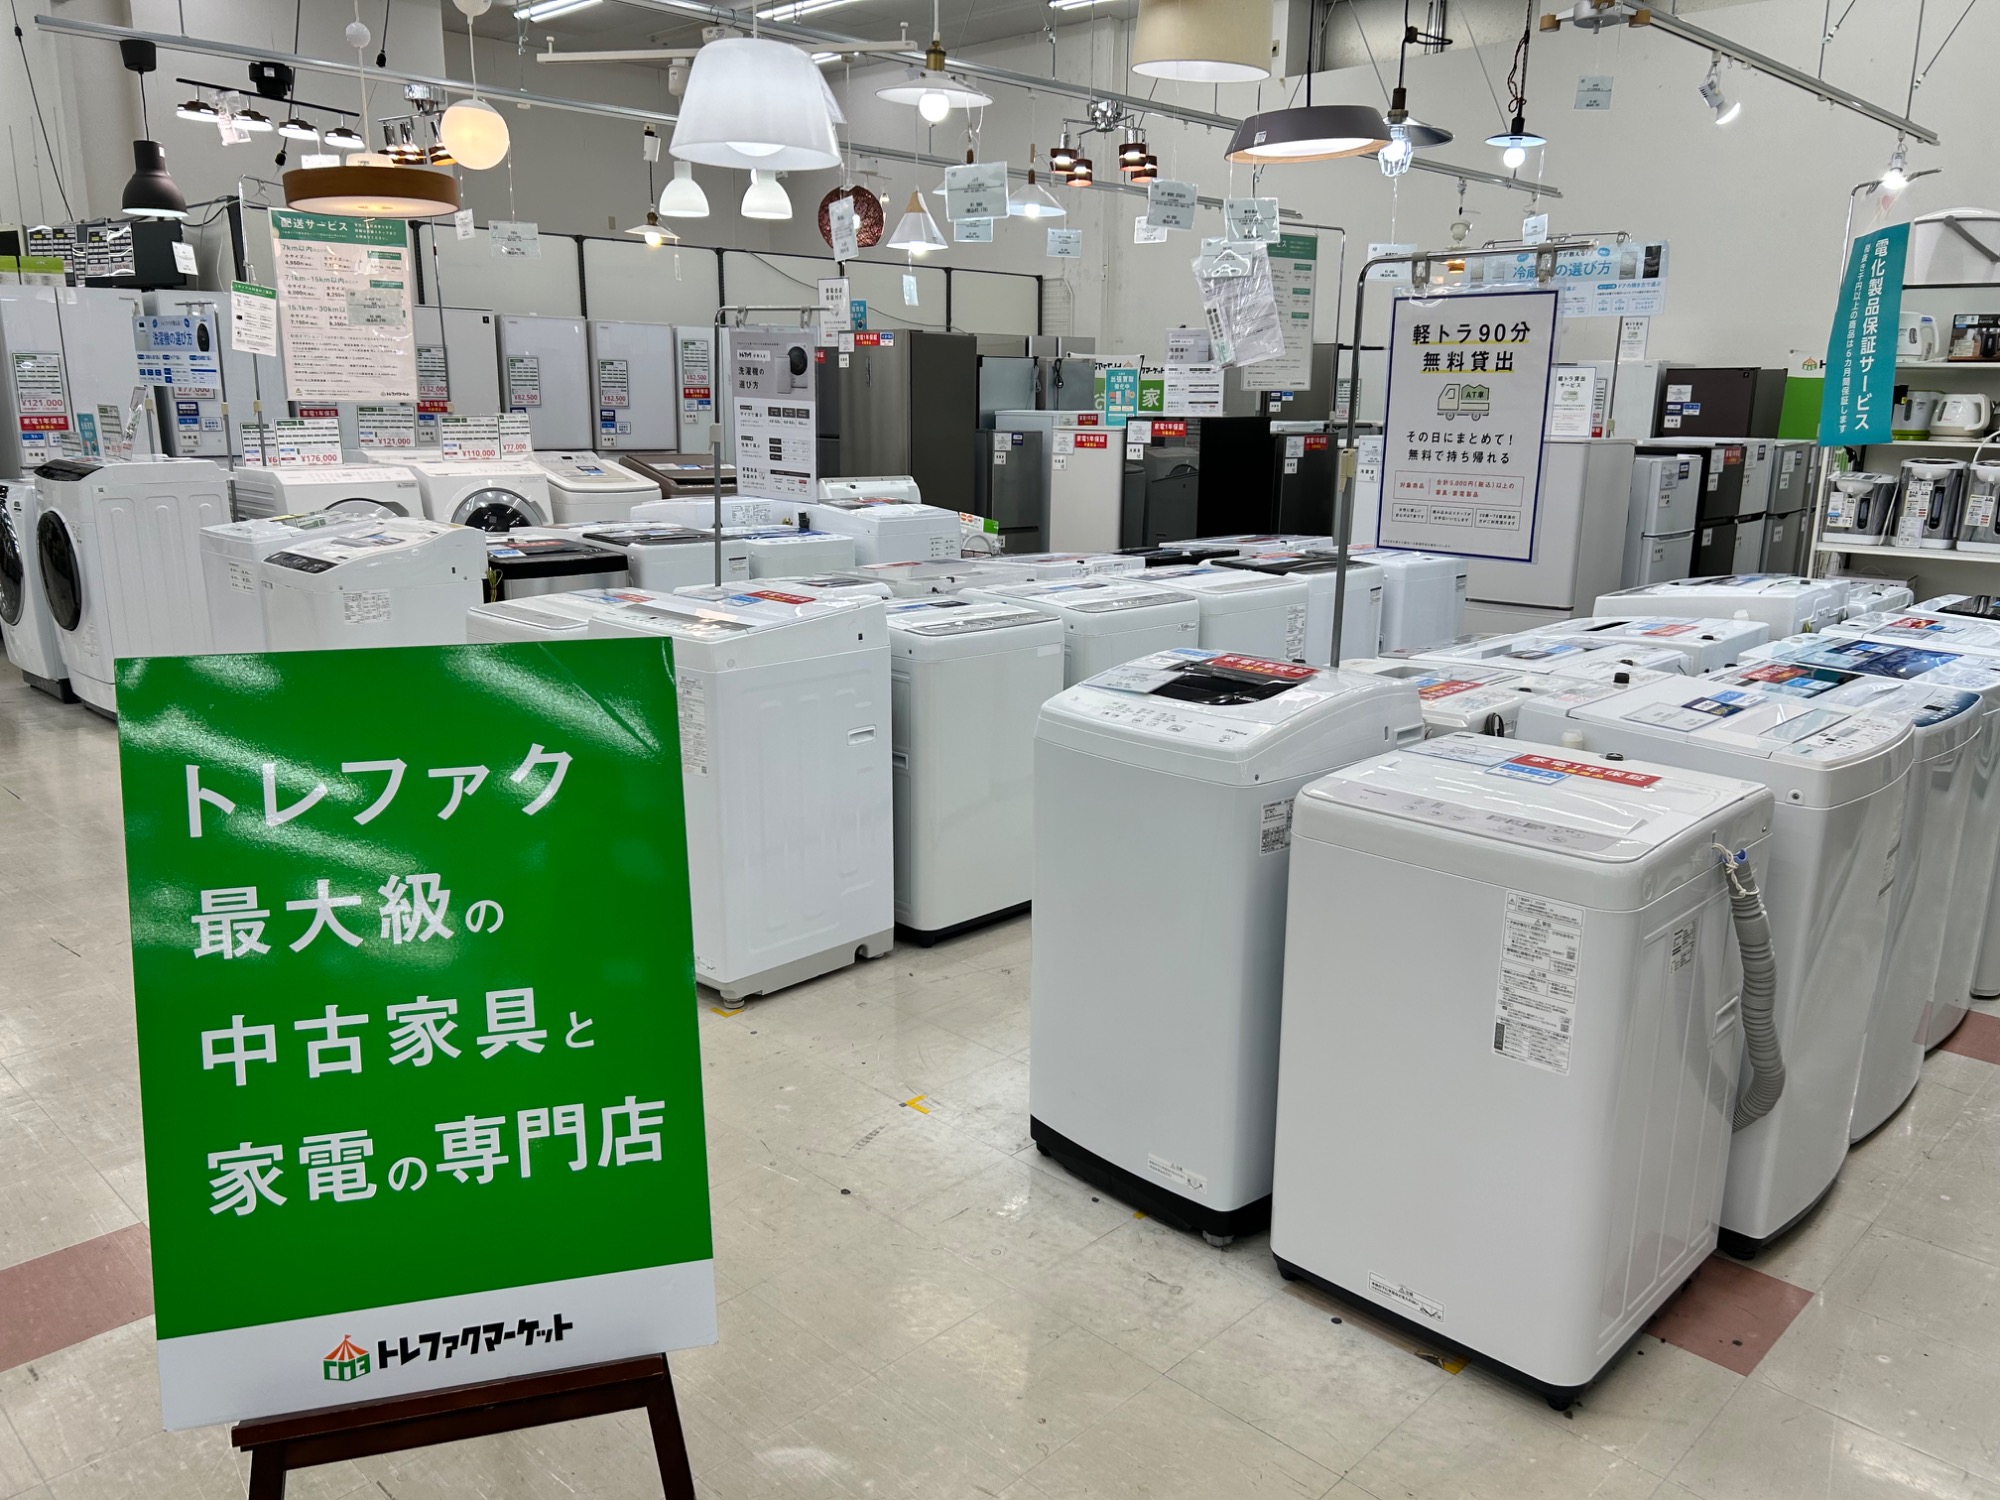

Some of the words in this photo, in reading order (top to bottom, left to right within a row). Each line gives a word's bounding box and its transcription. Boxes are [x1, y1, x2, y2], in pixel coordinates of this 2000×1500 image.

[280, 217, 348, 231] 配送サービス
[1513, 260, 1612, 280] 冷蔵の選び方
[1412, 321, 1531, 345] 軽トラ90分
[1854, 238, 1889, 430] 電化製品保証サービス
[1422, 350, 1514, 372] 無料貸出
[738, 366, 765, 376] 洗濯機の
[738, 380, 759, 389] 選び方
[1142, 388, 1160, 408] 家
[1465, 391, 1485, 399] AT車
[23, 417, 65, 425] 家電1年保証
[377, 437, 411, 445] ¥121,000
[1406, 430, 1513, 446] その日にまとめて!
[300, 453, 338, 463] ¥176,000
[462, 449, 496, 457] ¥110,000
[1407, 448, 1510, 464] 無料で持ち帰れる
[1400, 481, 1425, 489] 対象商品
[1527, 756, 1650, 782] 家電1年保証
[184, 743, 574, 839] トレファク
[190, 872, 505, 960] 最大級の
[200, 987, 595, 1087] 中古家具と
[206, 1095, 666, 1217] 家電の専門店
[377, 1313, 573, 1369] トレファクマーケット
